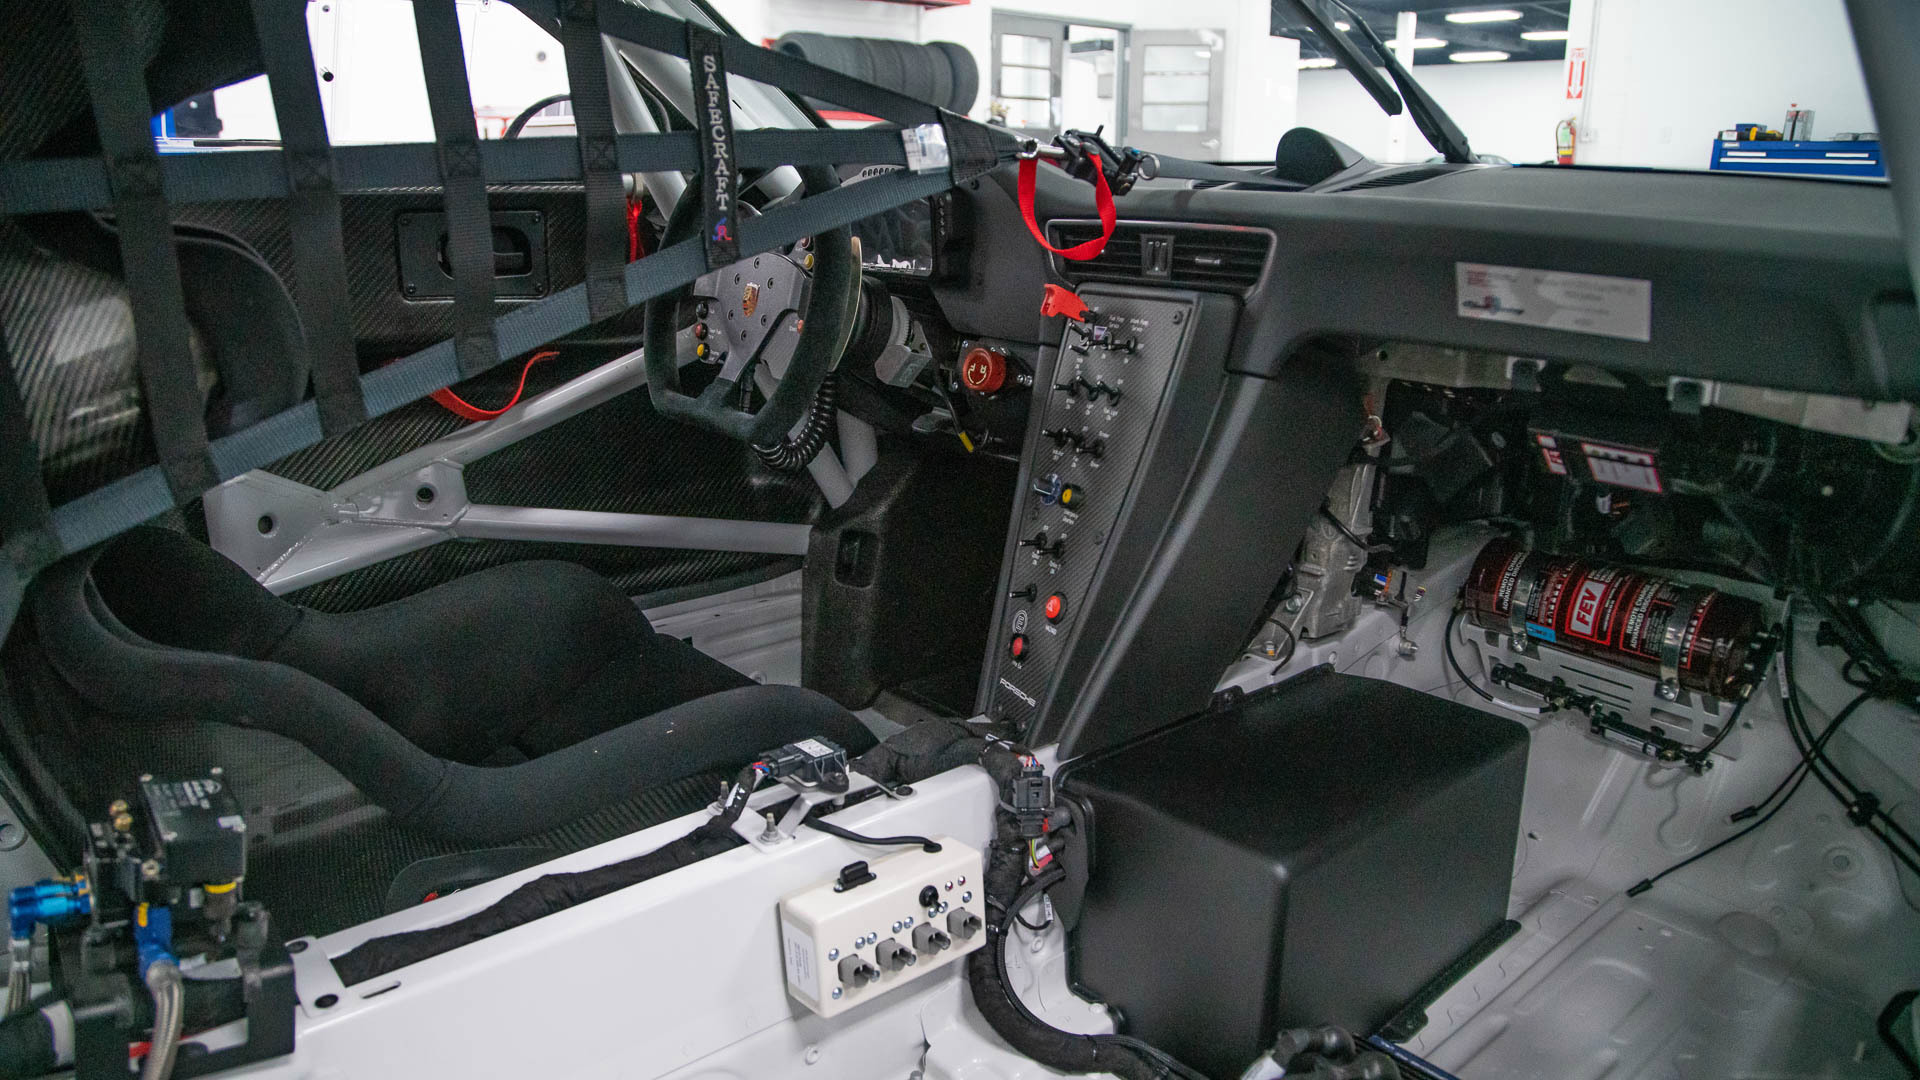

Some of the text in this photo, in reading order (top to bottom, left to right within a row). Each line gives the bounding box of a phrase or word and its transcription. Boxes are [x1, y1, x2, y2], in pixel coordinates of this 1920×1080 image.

[703, 54, 730, 211] SAFECRAFT
[1575, 588, 1597, 627] FEV
[999, 677, 1037, 708] PORSCHE
